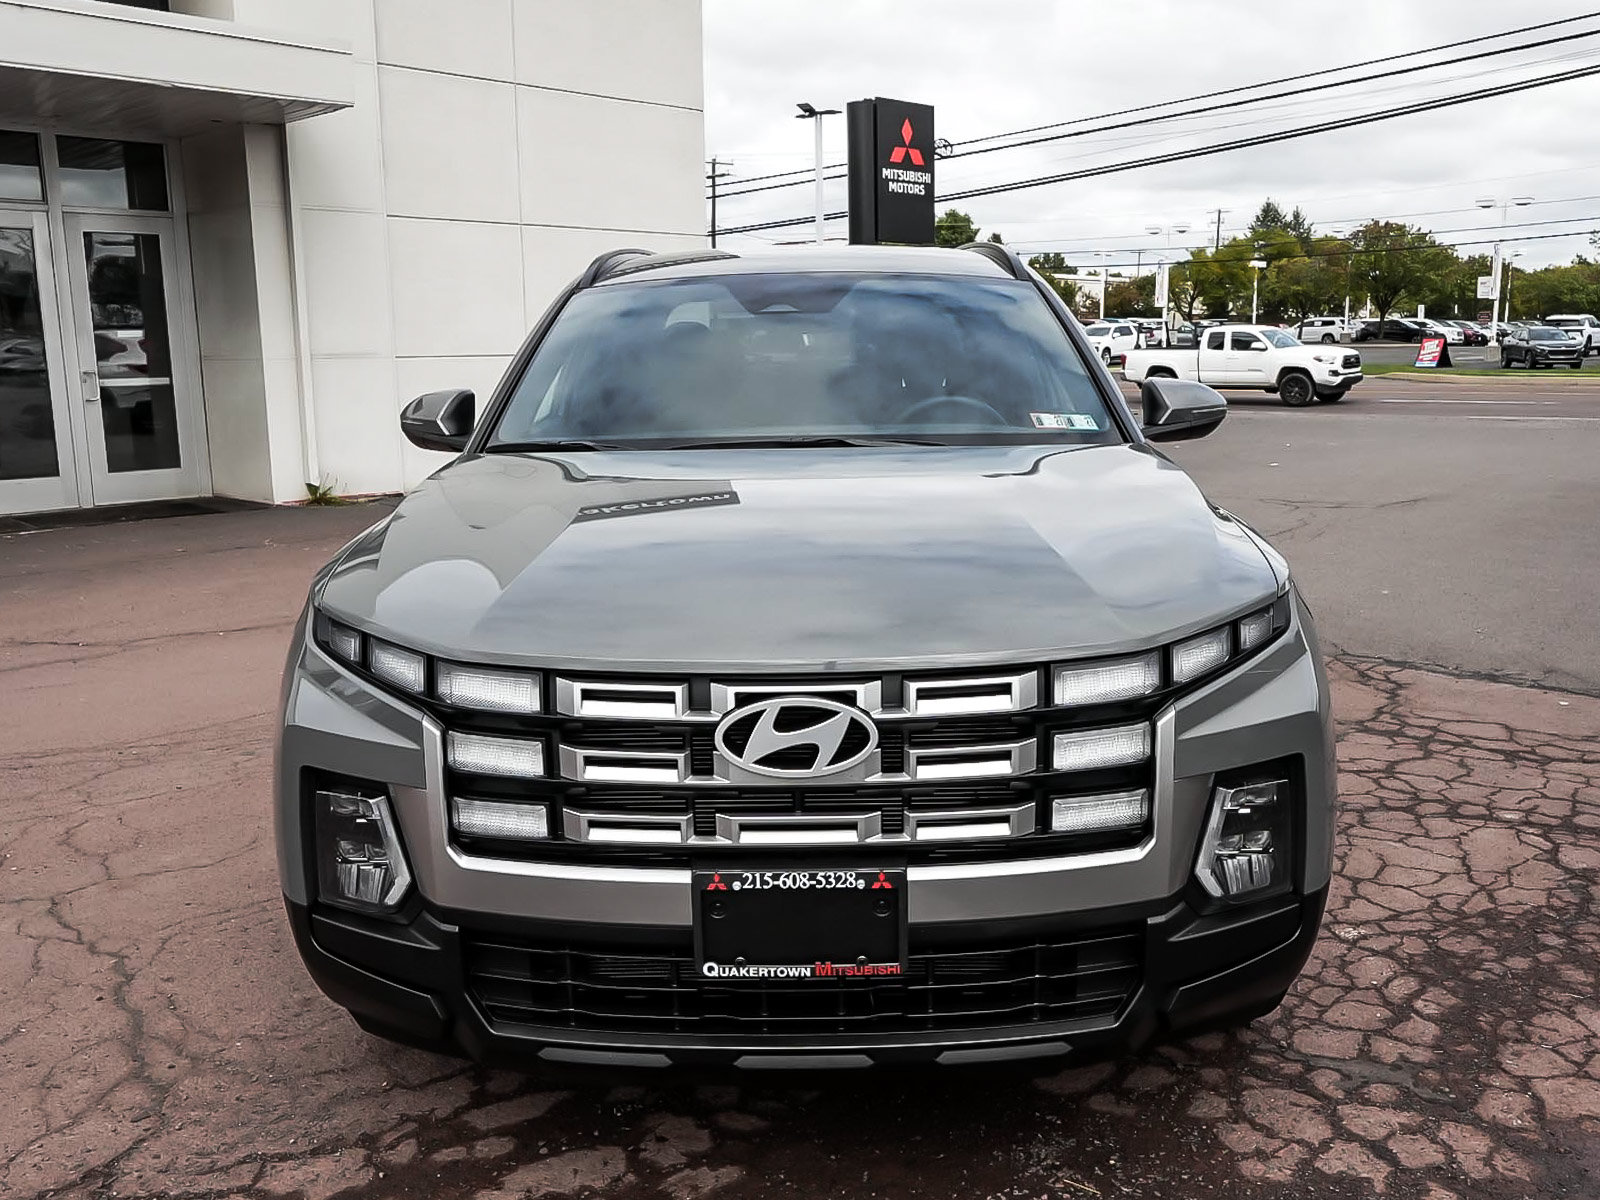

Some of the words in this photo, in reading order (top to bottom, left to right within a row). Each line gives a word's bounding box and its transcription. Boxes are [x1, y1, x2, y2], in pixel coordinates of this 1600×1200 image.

[882, 168, 931, 184] MITSUBISHI
[888, 181, 926, 195] MOTORS
[742, 872, 856, 889] 215-608-5328
